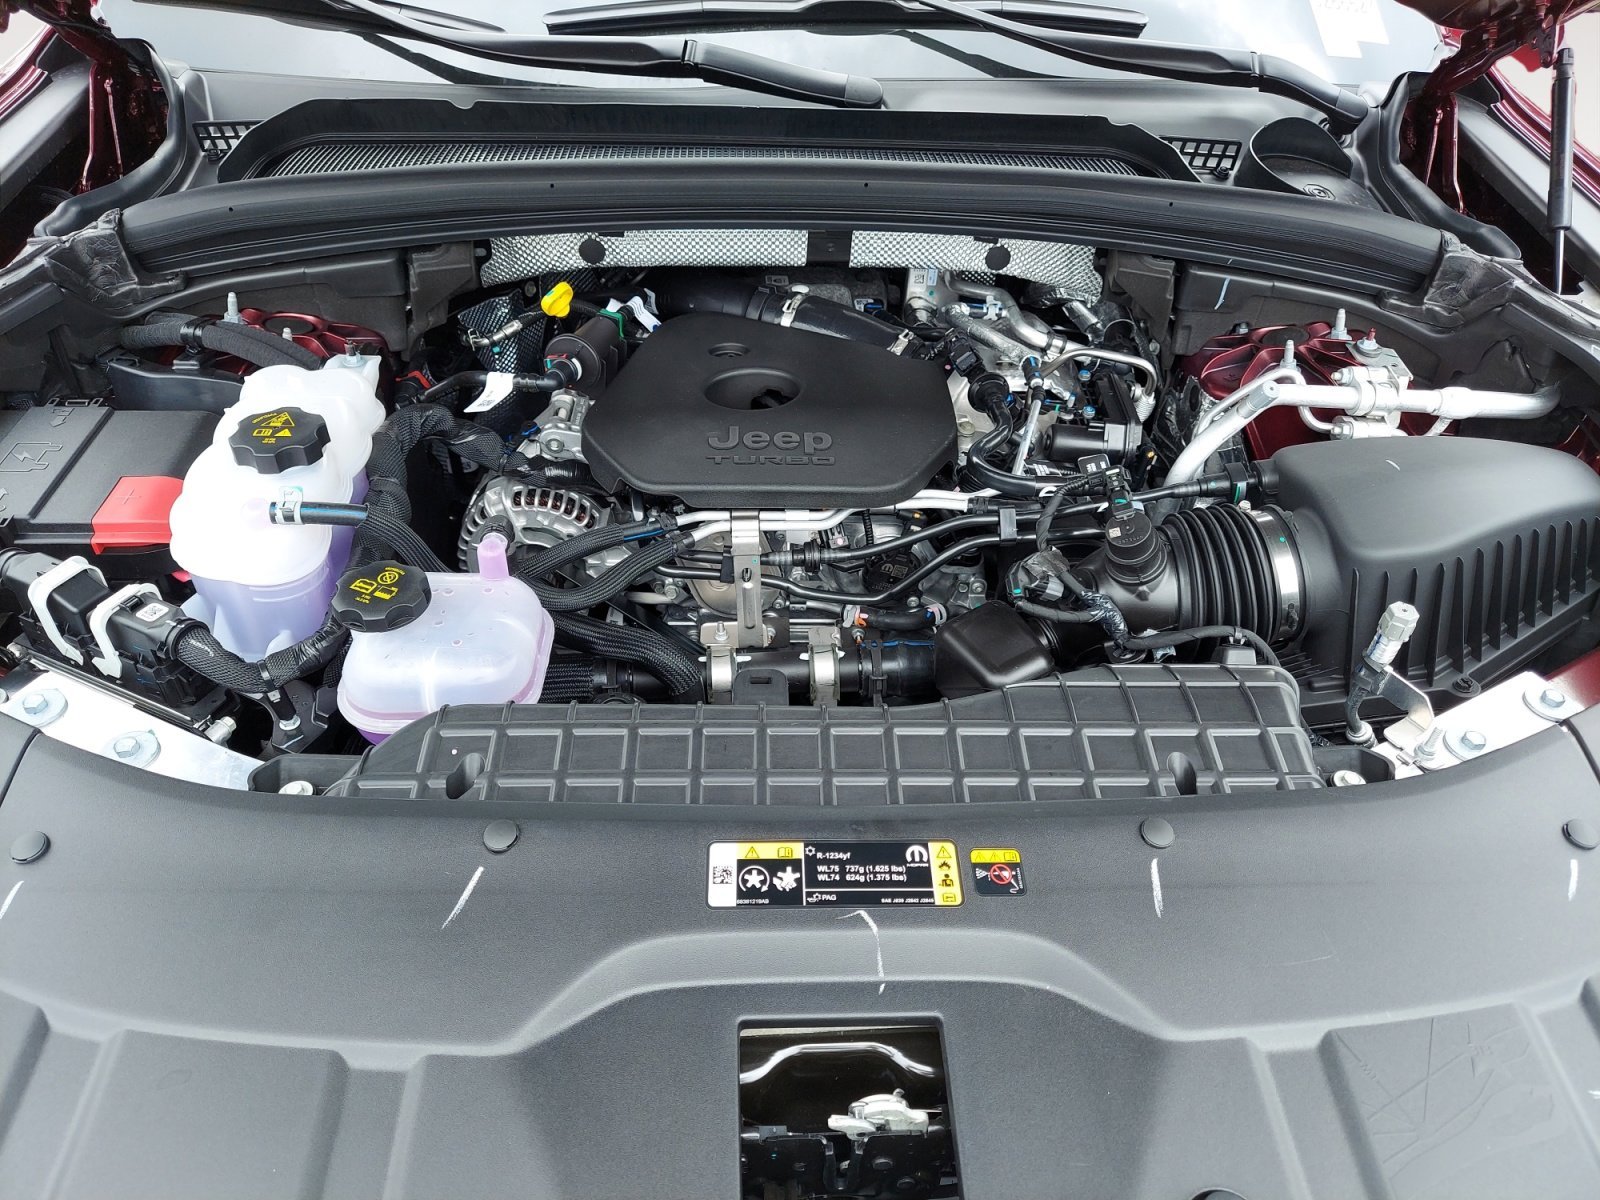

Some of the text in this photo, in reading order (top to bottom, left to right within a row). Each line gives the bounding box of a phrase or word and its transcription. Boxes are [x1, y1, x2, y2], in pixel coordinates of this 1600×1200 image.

[707, 425, 833, 455] Jeep
[705, 455, 836, 466] TURBO
[816, 852, 851, 861] R-1234yf
[817, 865, 907, 874] WL75 737g (1.625 lbs)
[817, 874, 907, 883] WL74 624g (1.375 lbs)
